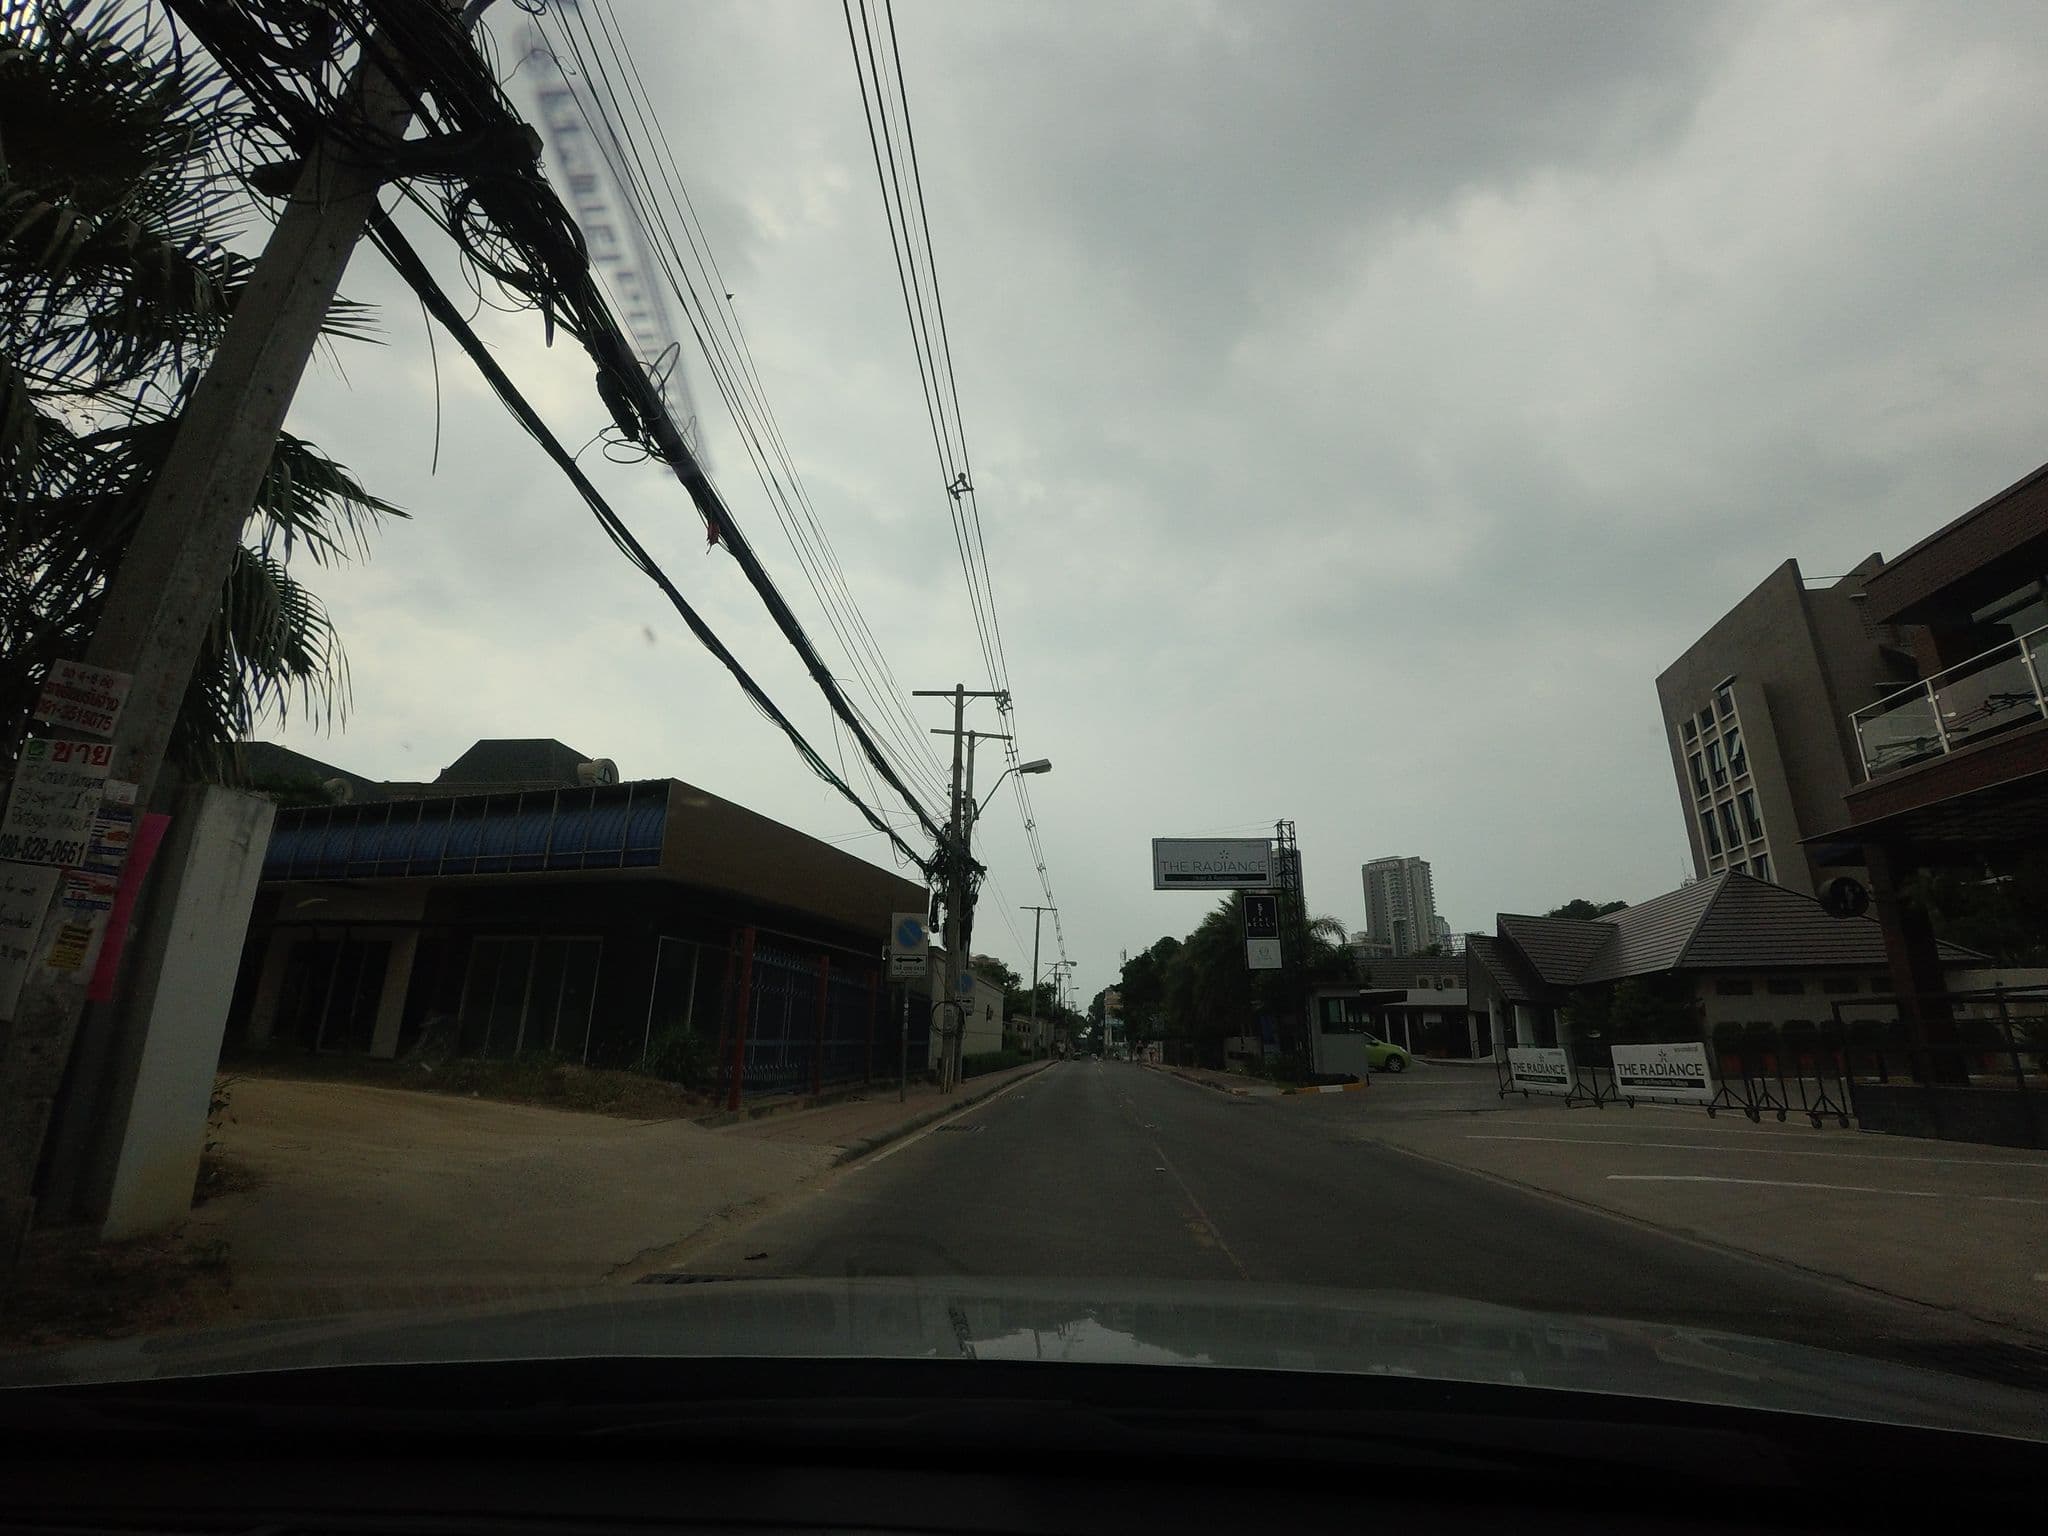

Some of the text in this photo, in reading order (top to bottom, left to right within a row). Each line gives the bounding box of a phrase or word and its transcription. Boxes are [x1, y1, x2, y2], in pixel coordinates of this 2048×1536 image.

[51, 741, 112, 768] ขาย
[1160, 860, 1267, 873] THE RADIANCE
[1513, 1062, 1567, 1075] THE RADIANCE
[1617, 1063, 1705, 1076] THE RADIANCE
